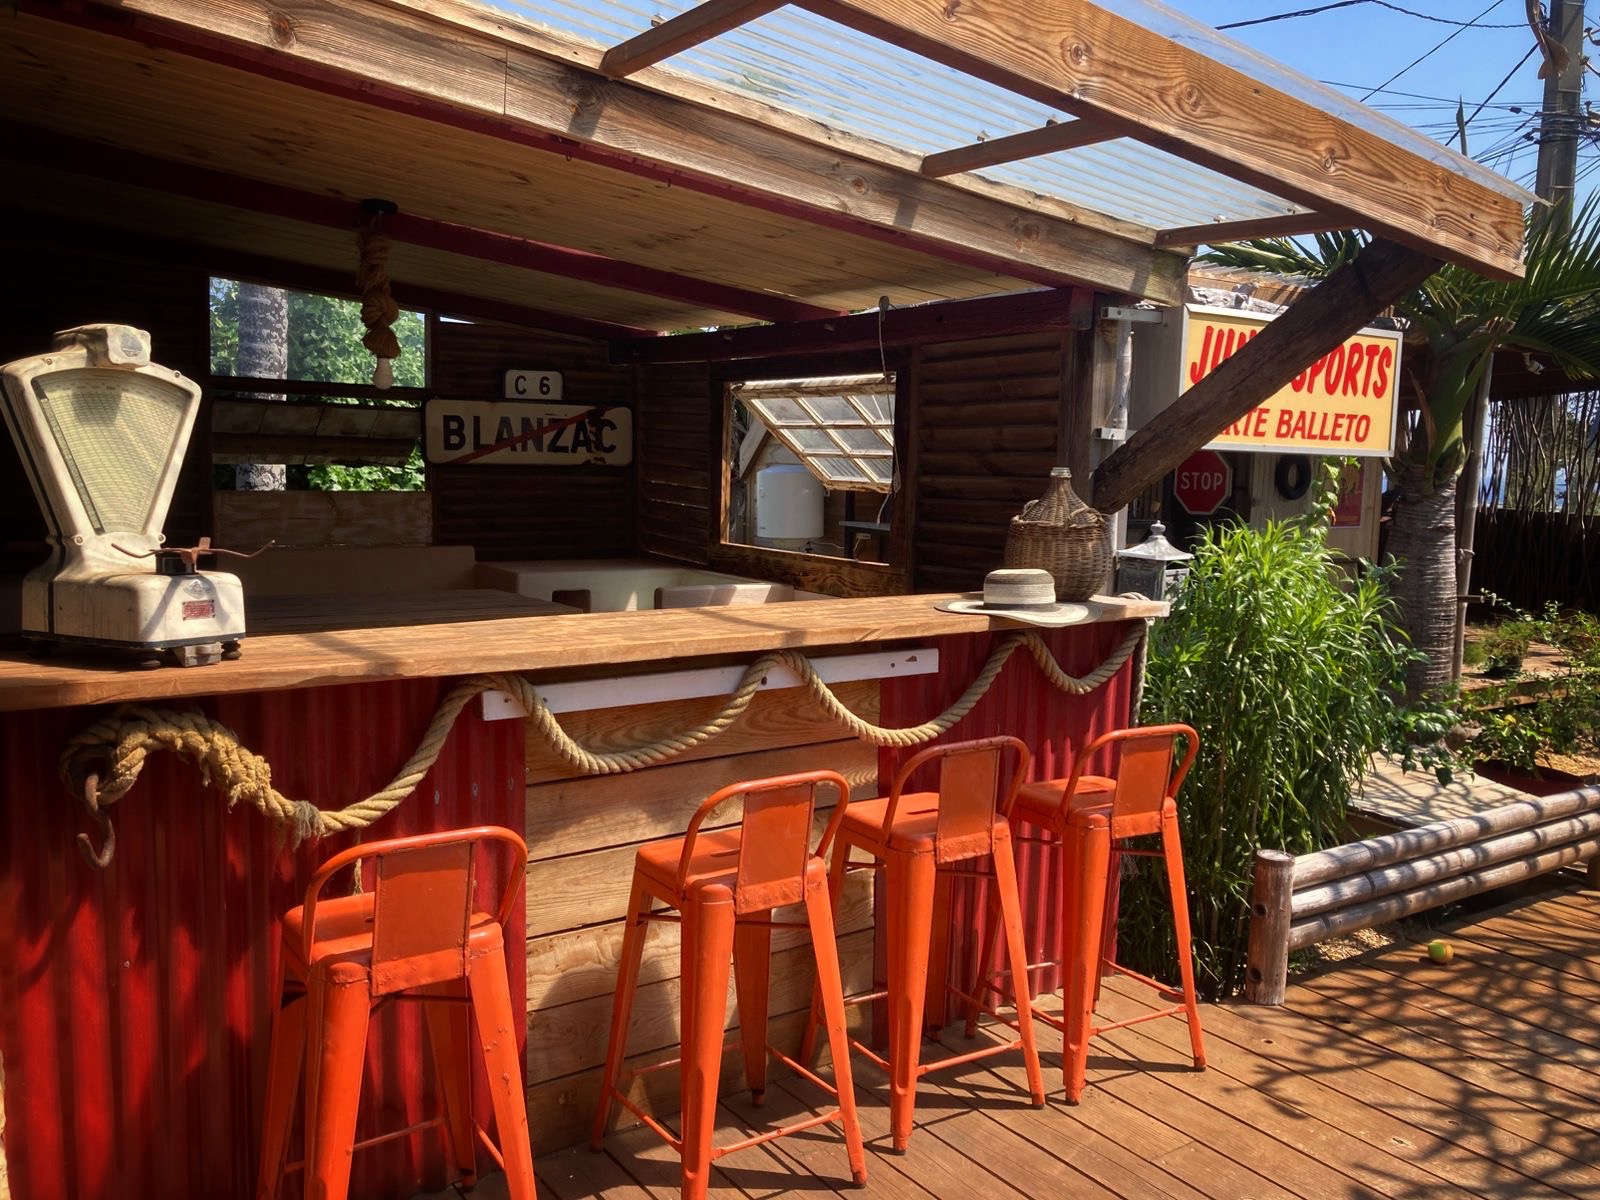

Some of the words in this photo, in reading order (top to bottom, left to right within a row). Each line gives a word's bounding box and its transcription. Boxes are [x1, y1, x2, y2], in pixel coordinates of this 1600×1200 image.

[514, 375, 527, 395] C
[538, 376, 551, 396] 6
[442, 414, 617, 454] BLANZAC
[1275, 409, 1371, 443] BALLETO
[1180, 470, 1224, 491] STOP
